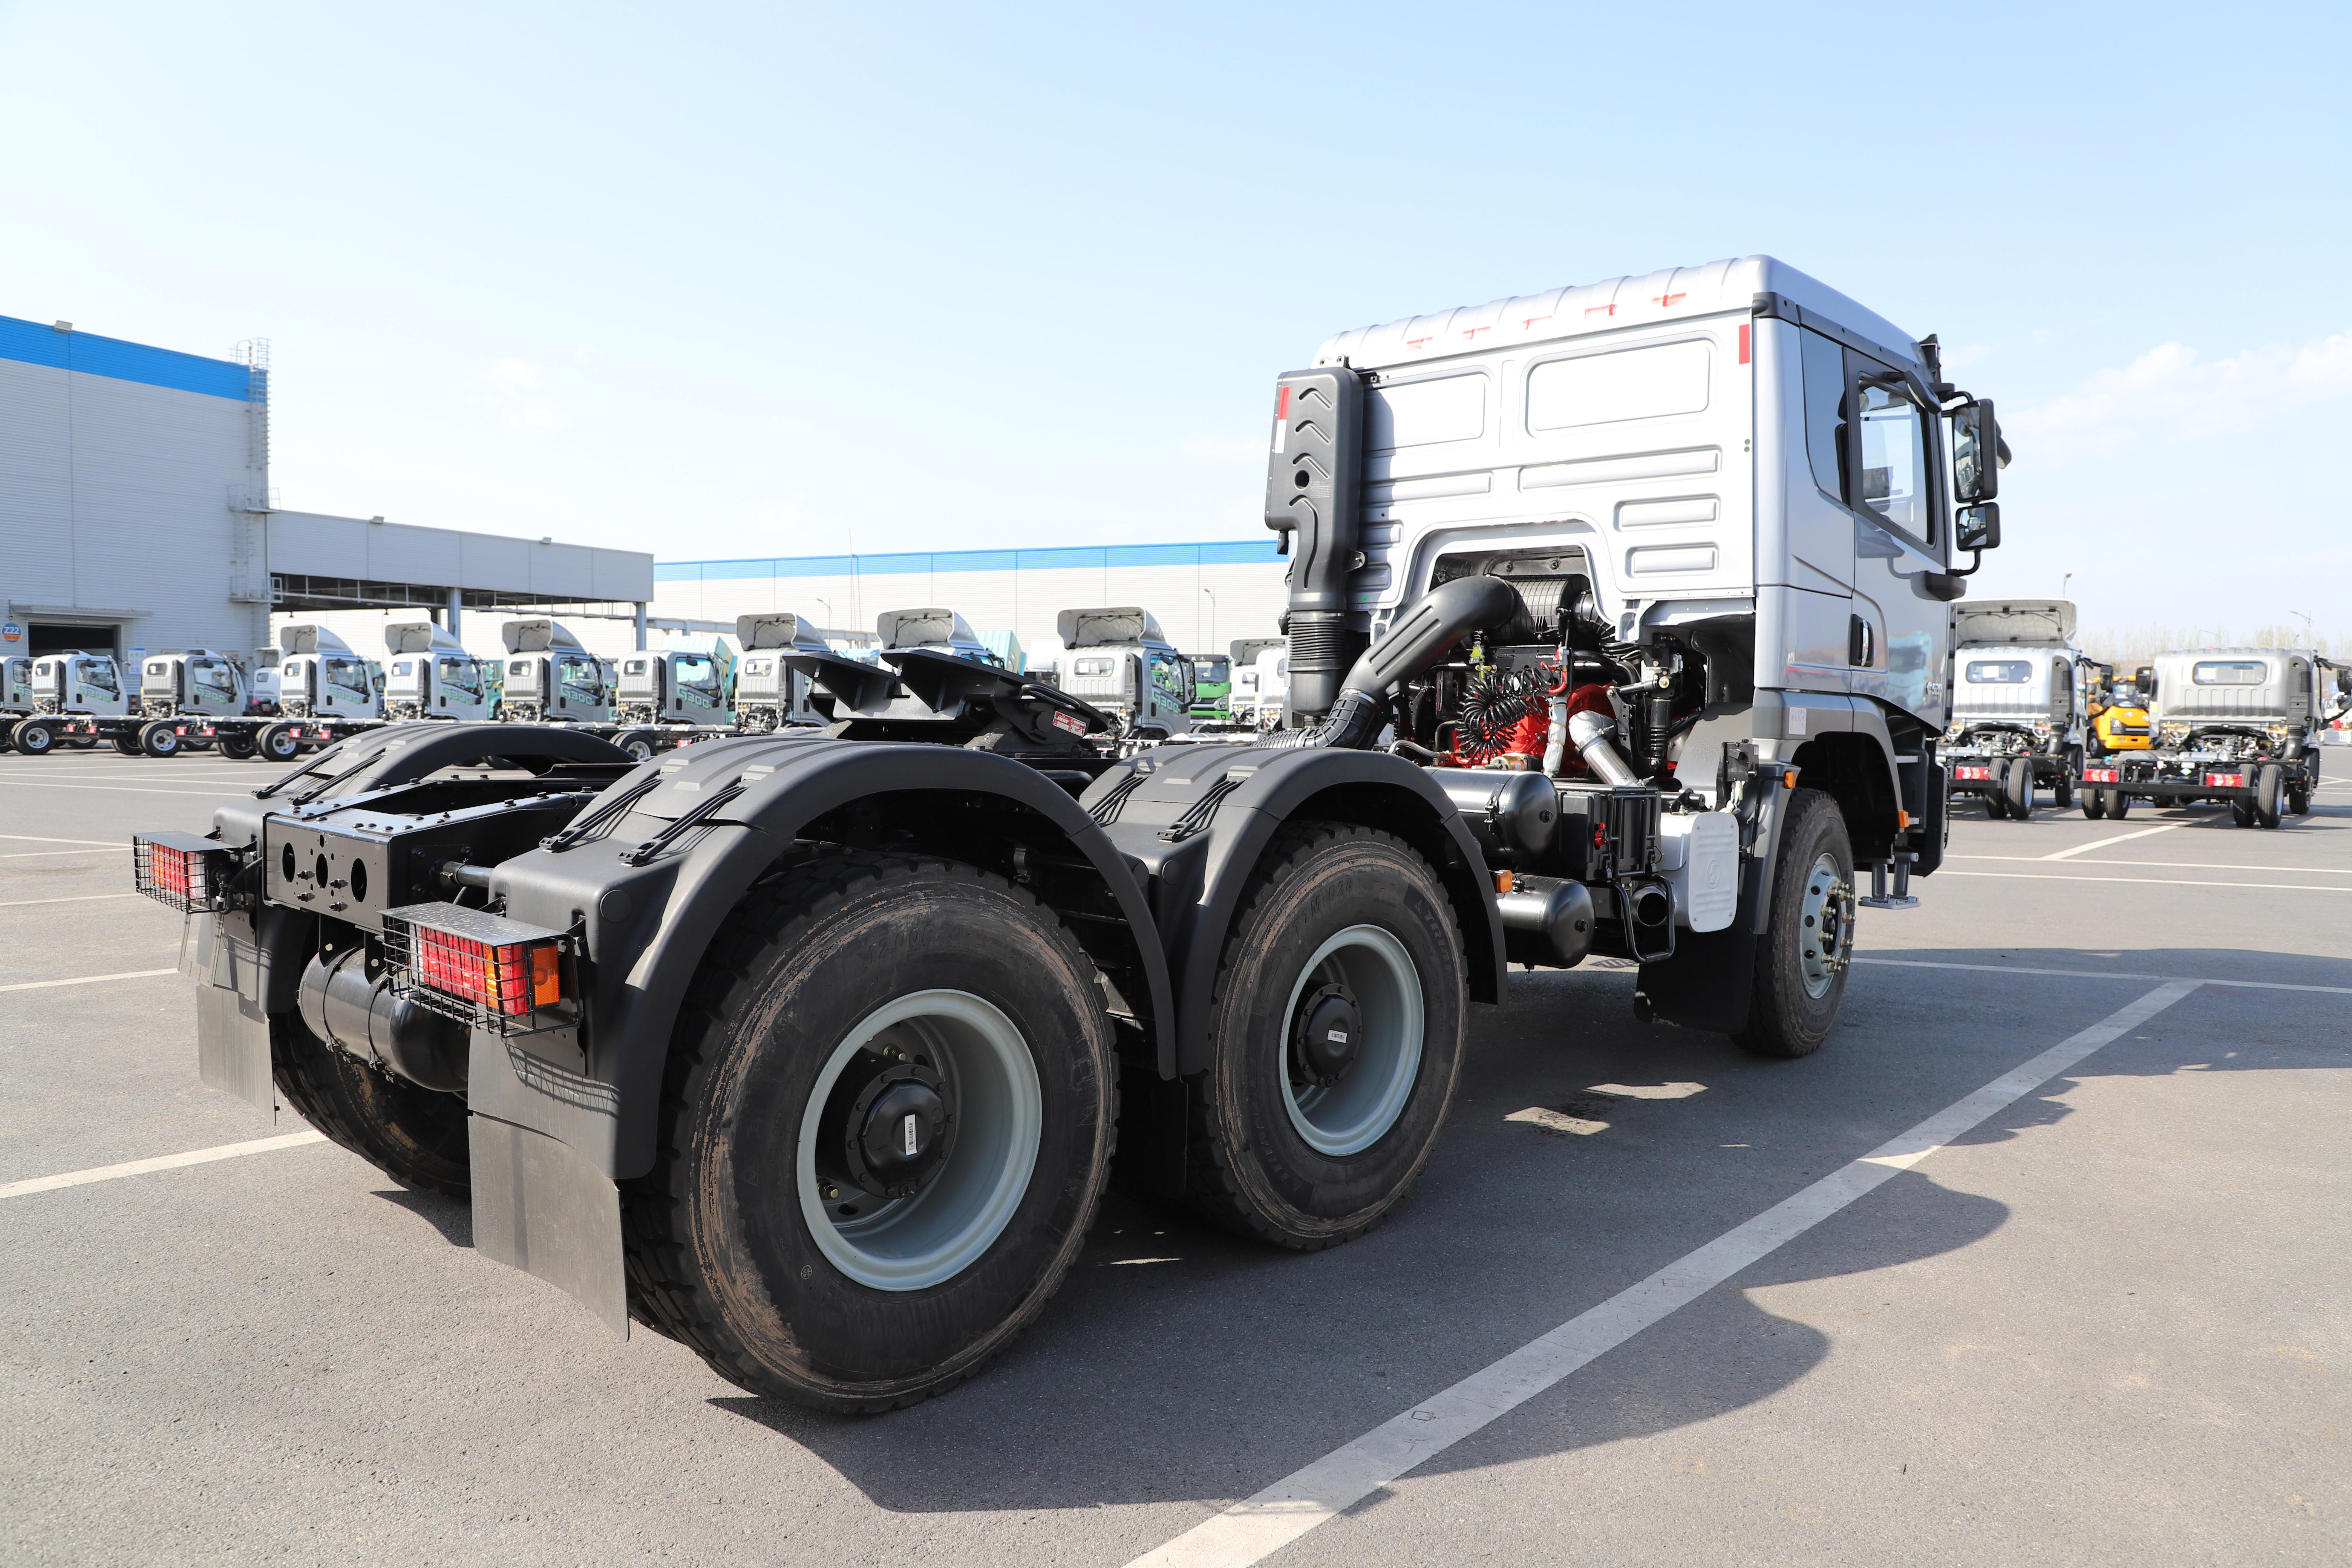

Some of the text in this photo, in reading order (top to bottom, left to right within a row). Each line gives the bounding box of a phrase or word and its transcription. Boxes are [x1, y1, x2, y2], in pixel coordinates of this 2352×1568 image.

[867, 924, 966, 963] 12.00R20
[1424, 909, 1456, 1034] TRIANGLE
[1249, 1045, 1290, 1187] TRIANGLE
